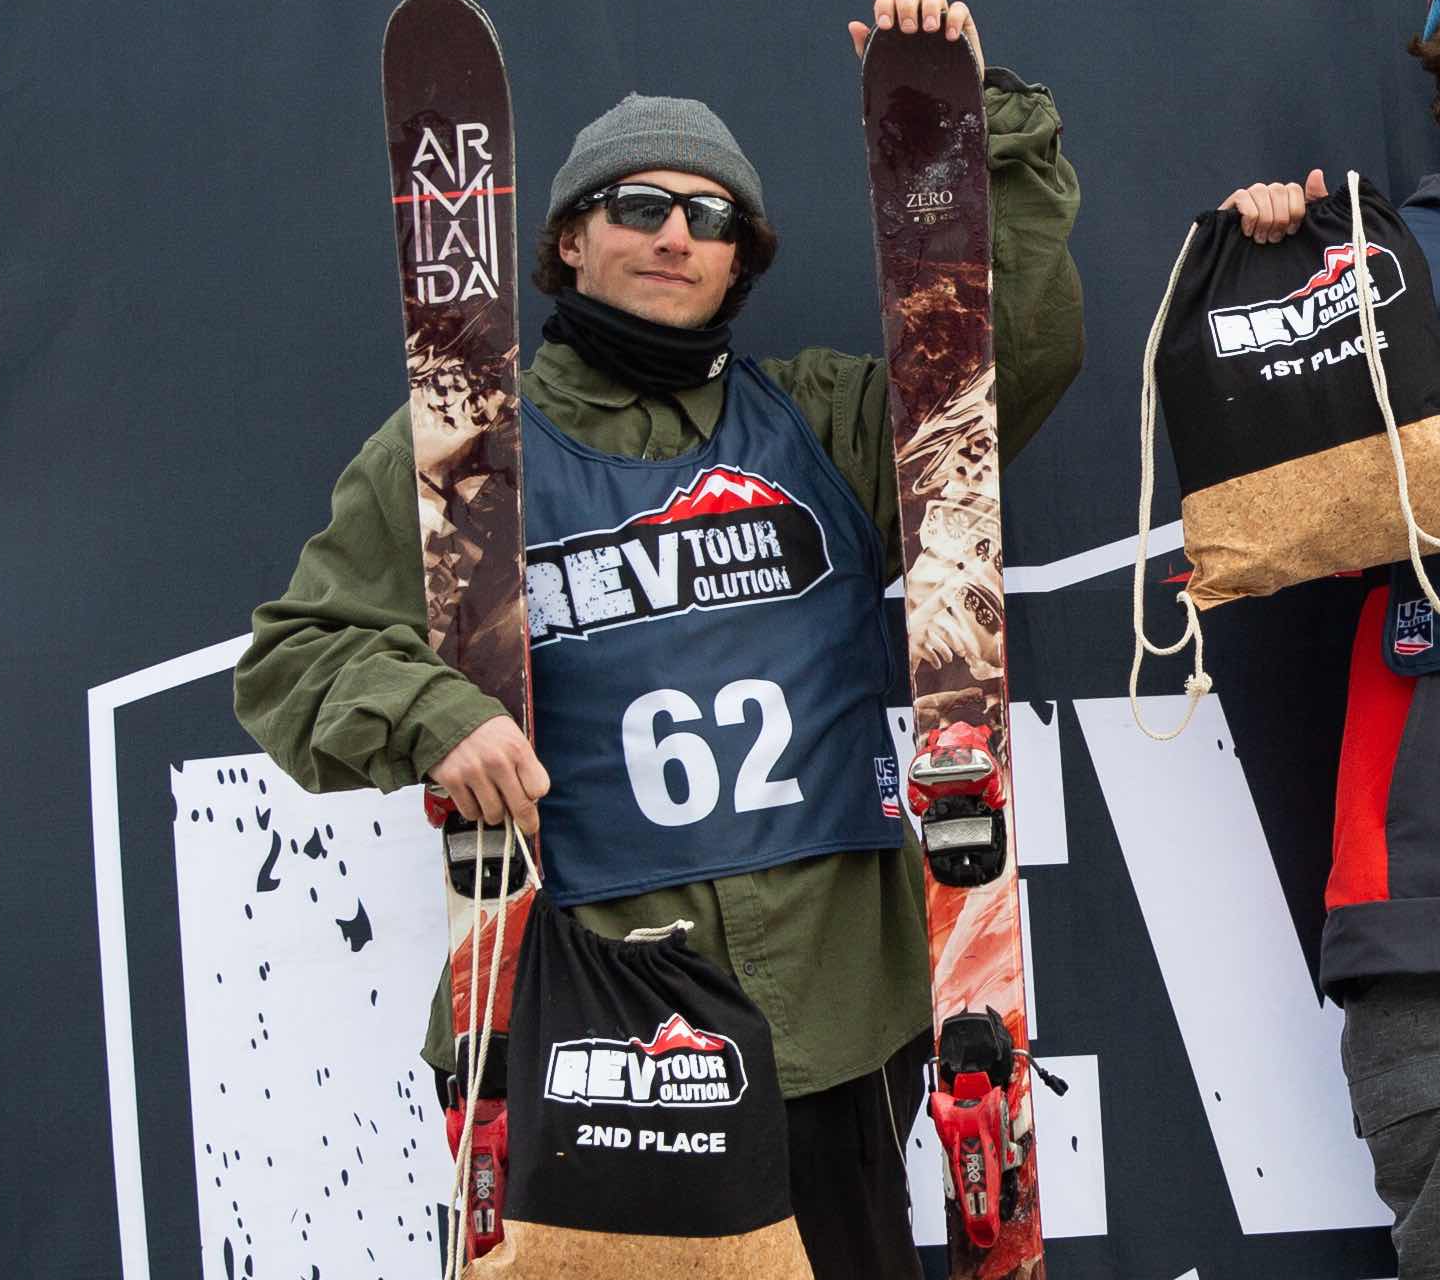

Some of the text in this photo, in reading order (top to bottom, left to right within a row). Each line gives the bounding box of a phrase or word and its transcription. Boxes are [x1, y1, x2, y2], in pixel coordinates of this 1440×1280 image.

[906, 190, 953, 208] ZERO
[1214, 295, 1314, 351] REV
[1260, 358, 1304, 380] 1ST
[681, 520, 783, 568] TOUR
[693, 565, 792, 602] OLUTION
[621, 678, 805, 827] 62
[551, 1049, 727, 1100] REV TOUR
[660, 1082, 730, 1101] OLUTION
[576, 1125, 727, 1153] 2ND PLACE
